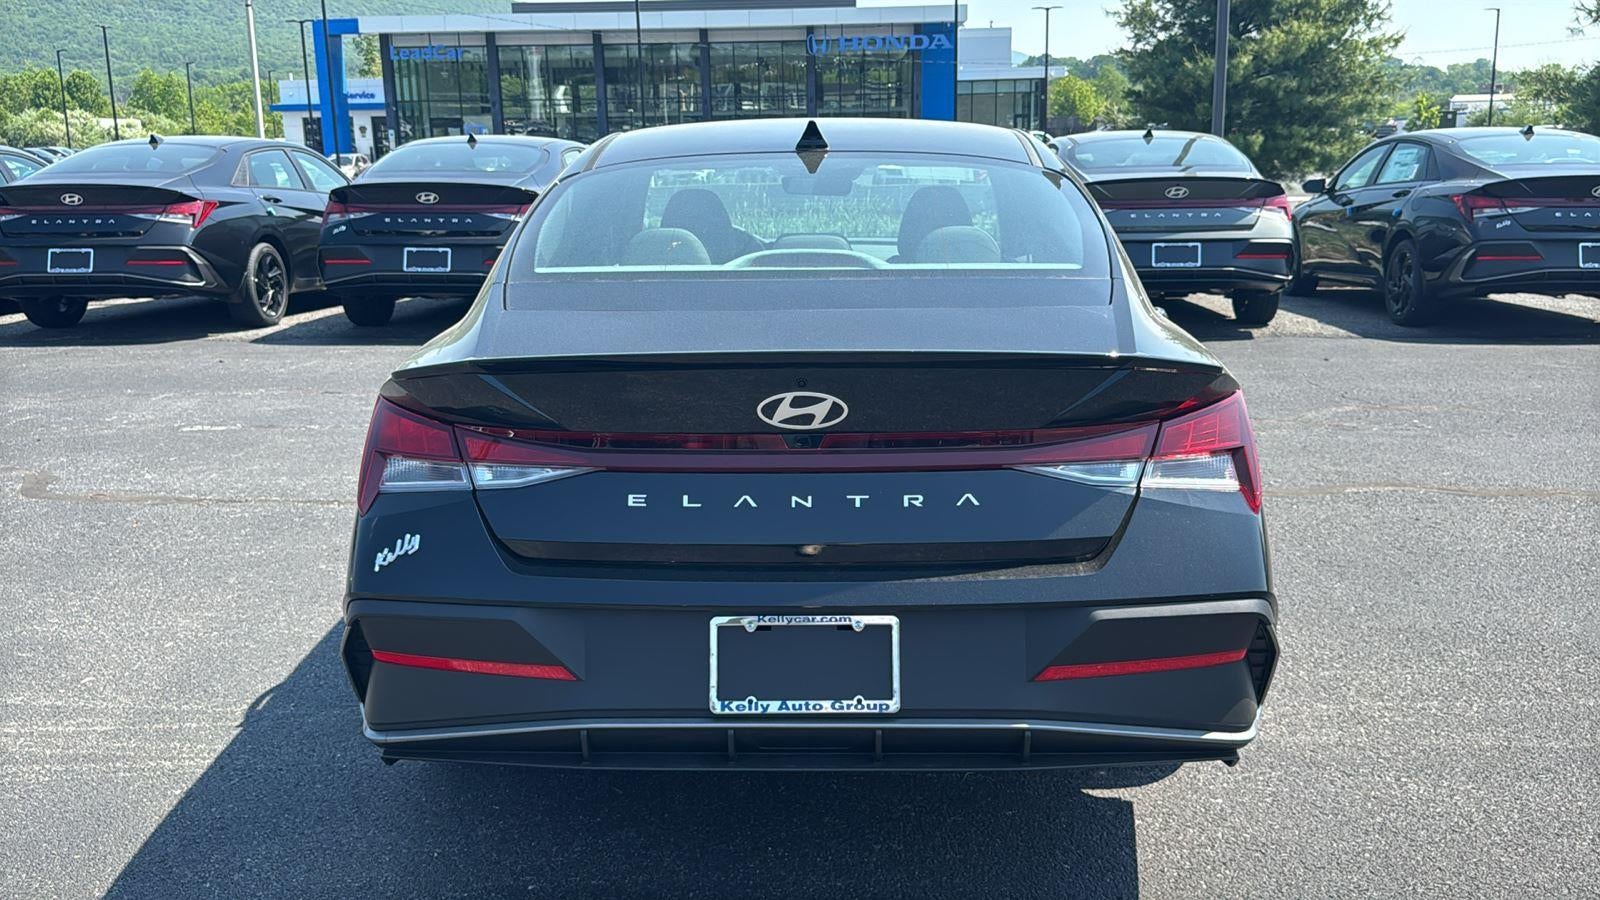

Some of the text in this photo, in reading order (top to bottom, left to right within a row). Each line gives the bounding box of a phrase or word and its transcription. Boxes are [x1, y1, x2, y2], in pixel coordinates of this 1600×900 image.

[837, 34, 954, 51] HONDA
[389, 44, 463, 61] LeadCar
[627, 492, 981, 508] ELANTRA
[374, 533, 420, 572] Kelly
[757, 615, 853, 625] Kellycar.com
[720, 700, 890, 714] Kelly Auto Group
